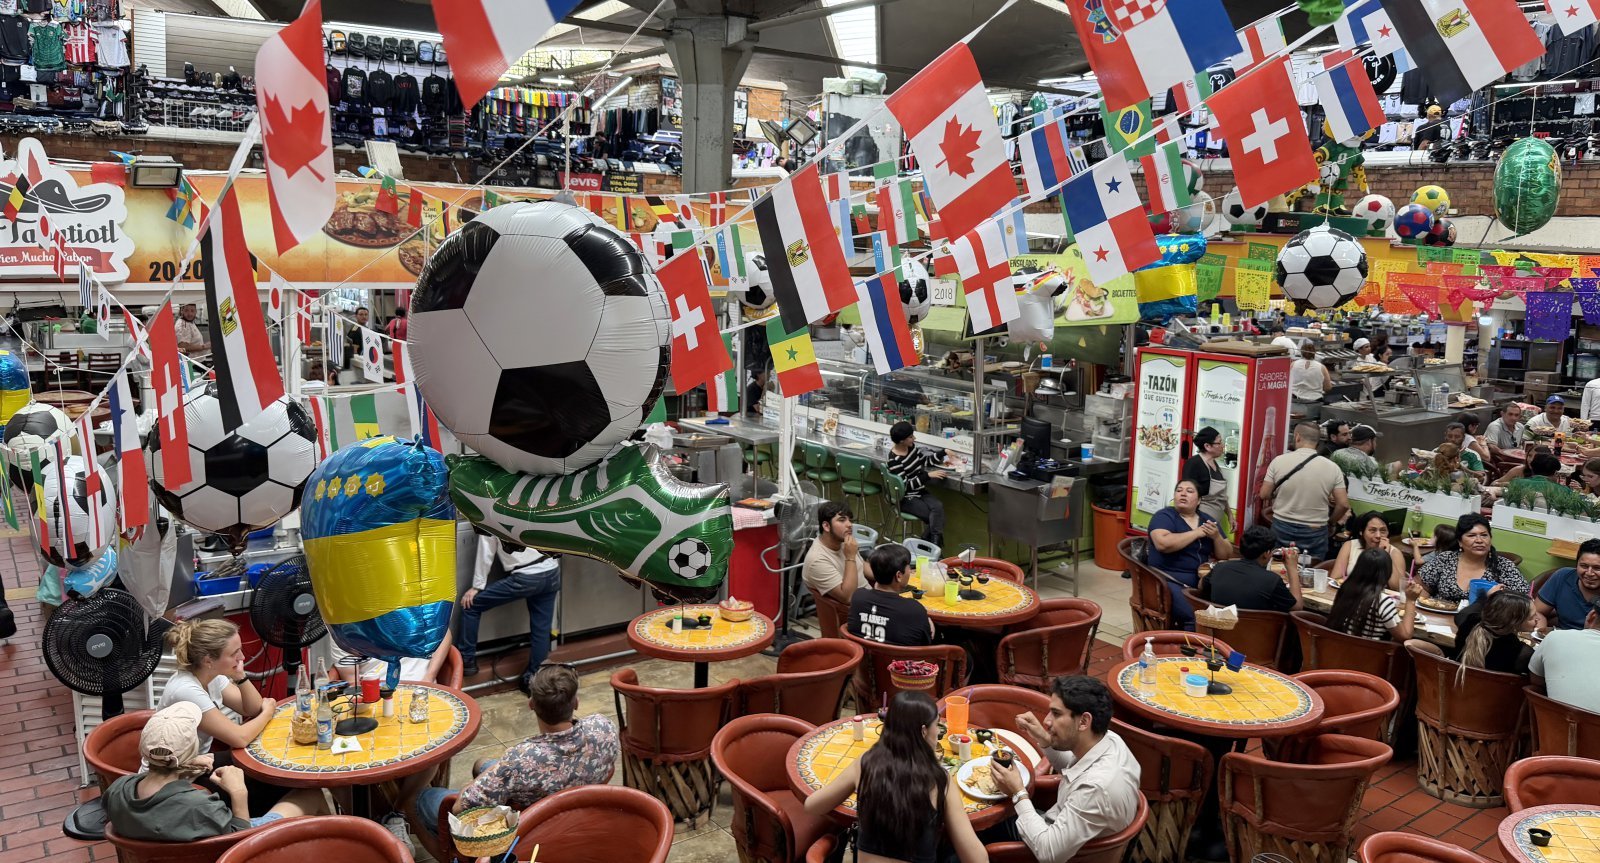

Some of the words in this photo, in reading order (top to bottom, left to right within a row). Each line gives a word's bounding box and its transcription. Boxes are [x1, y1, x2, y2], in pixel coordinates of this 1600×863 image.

[21, 251, 55, 263] Mucho
[934, 288, 953, 300] 2018
[1259, 372, 1287, 381] SABOREA
[1148, 374, 1178, 393] TAZÓN
[1258, 382, 1266, 390] LA
[1267, 380, 1287, 390] MAGIA
[1163, 412, 1173, 422] 99
[1398, 489, 1425, 503] Green
